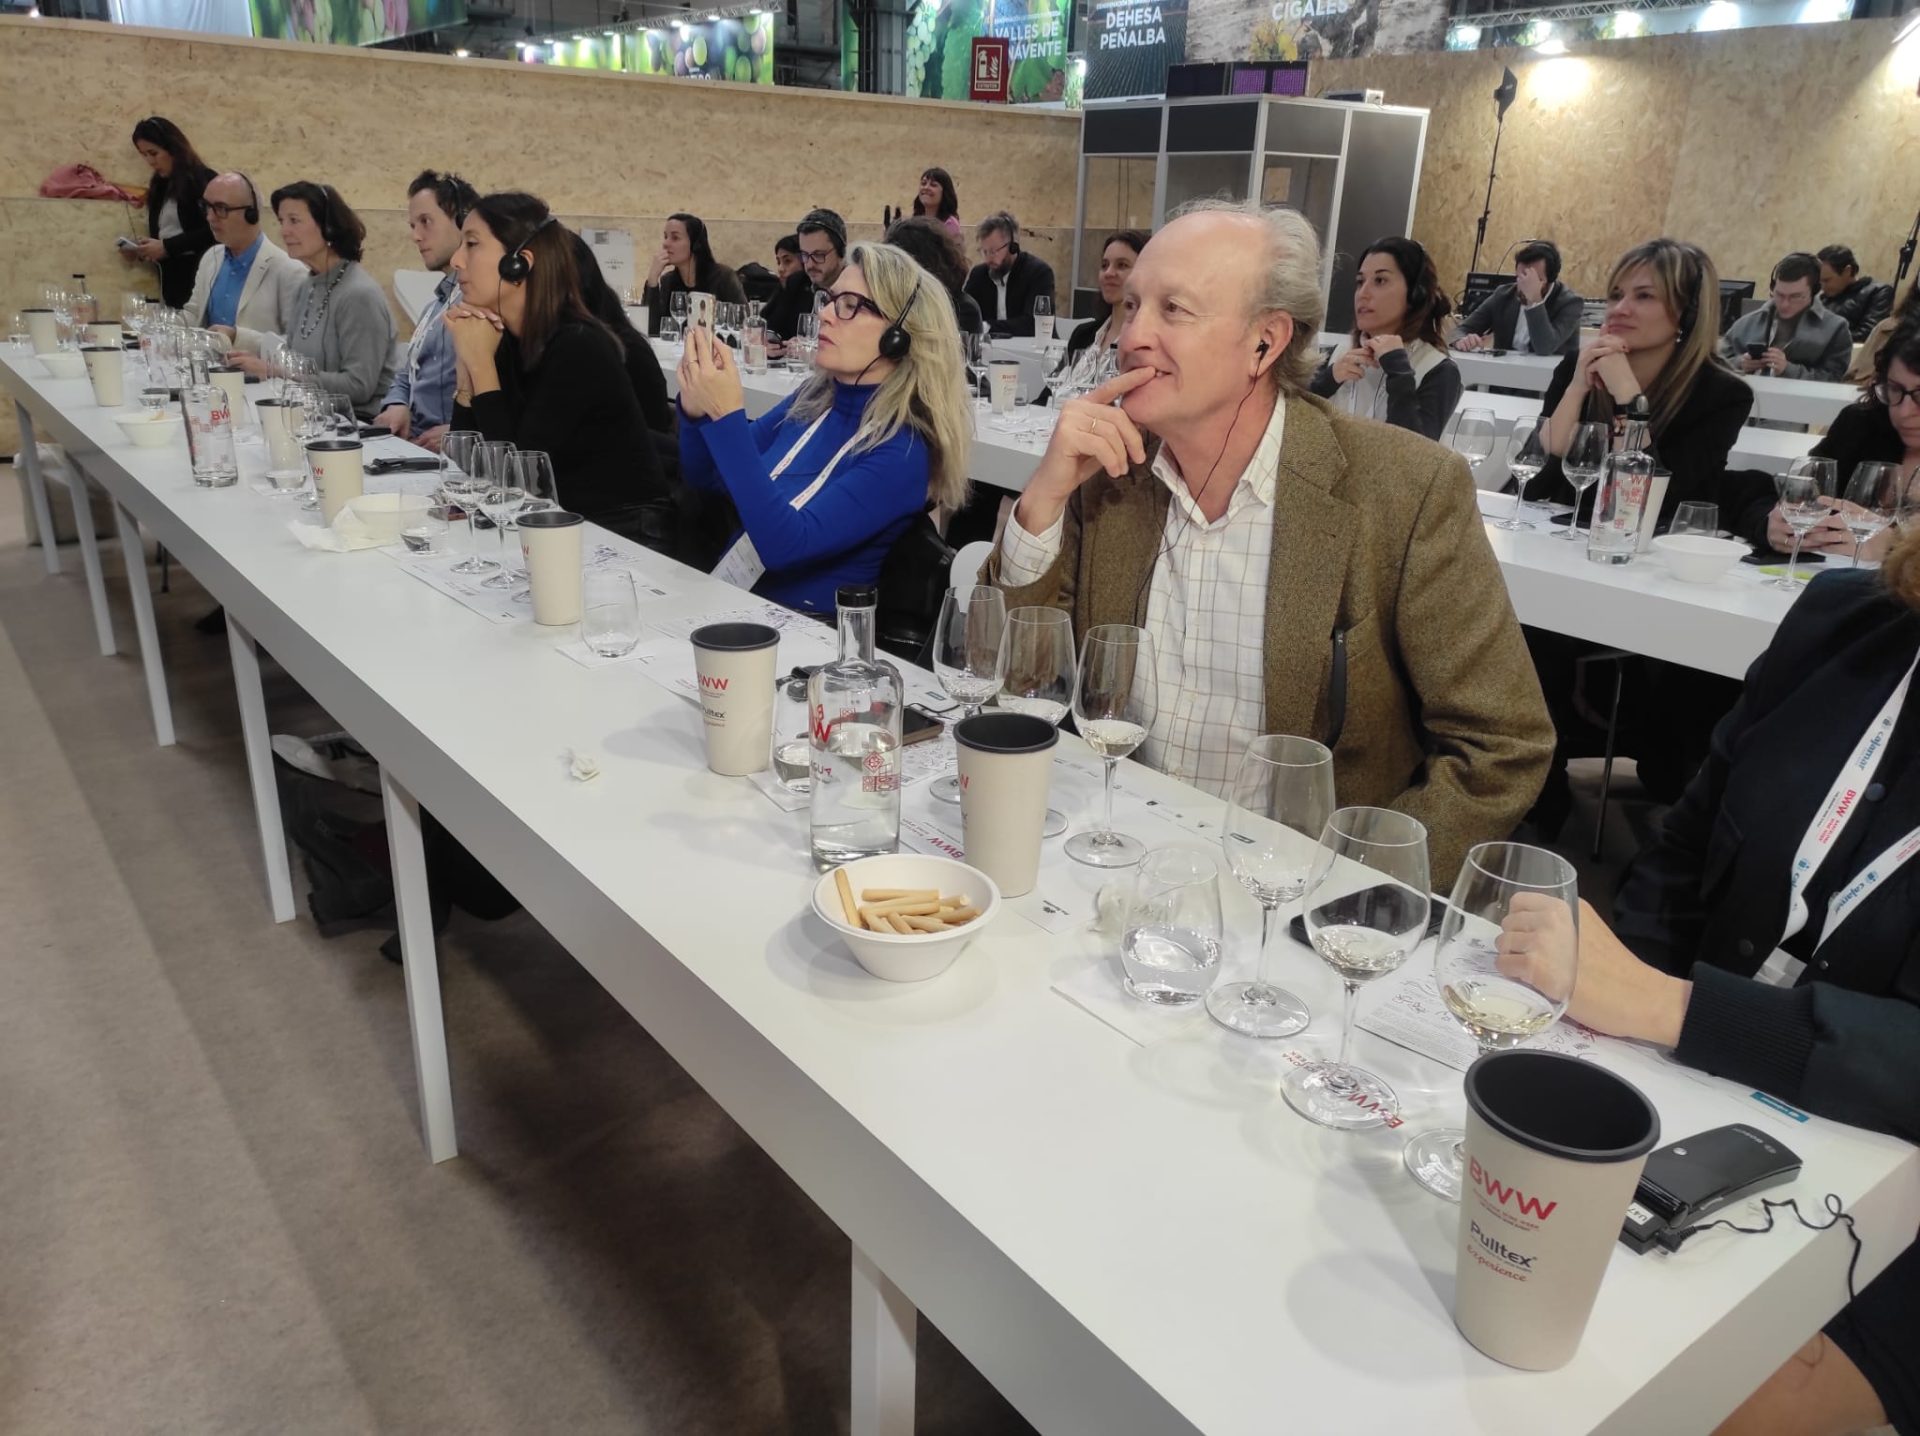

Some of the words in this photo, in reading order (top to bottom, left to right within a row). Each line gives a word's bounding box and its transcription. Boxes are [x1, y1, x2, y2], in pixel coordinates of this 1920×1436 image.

[1106, 6, 1163, 29] DEHESA
[1272, 0, 1349, 20] CIGALES
[995, 23, 1038, 41] VALLES
[1042, 20, 1059, 37] DE
[1100, 27, 1166, 50] PEÑALBA
[1008, 40, 1062, 60] NAVENTE
[1469, 1155, 1557, 1220] BWW
[1470, 1220, 1532, 1268] Pulltex
